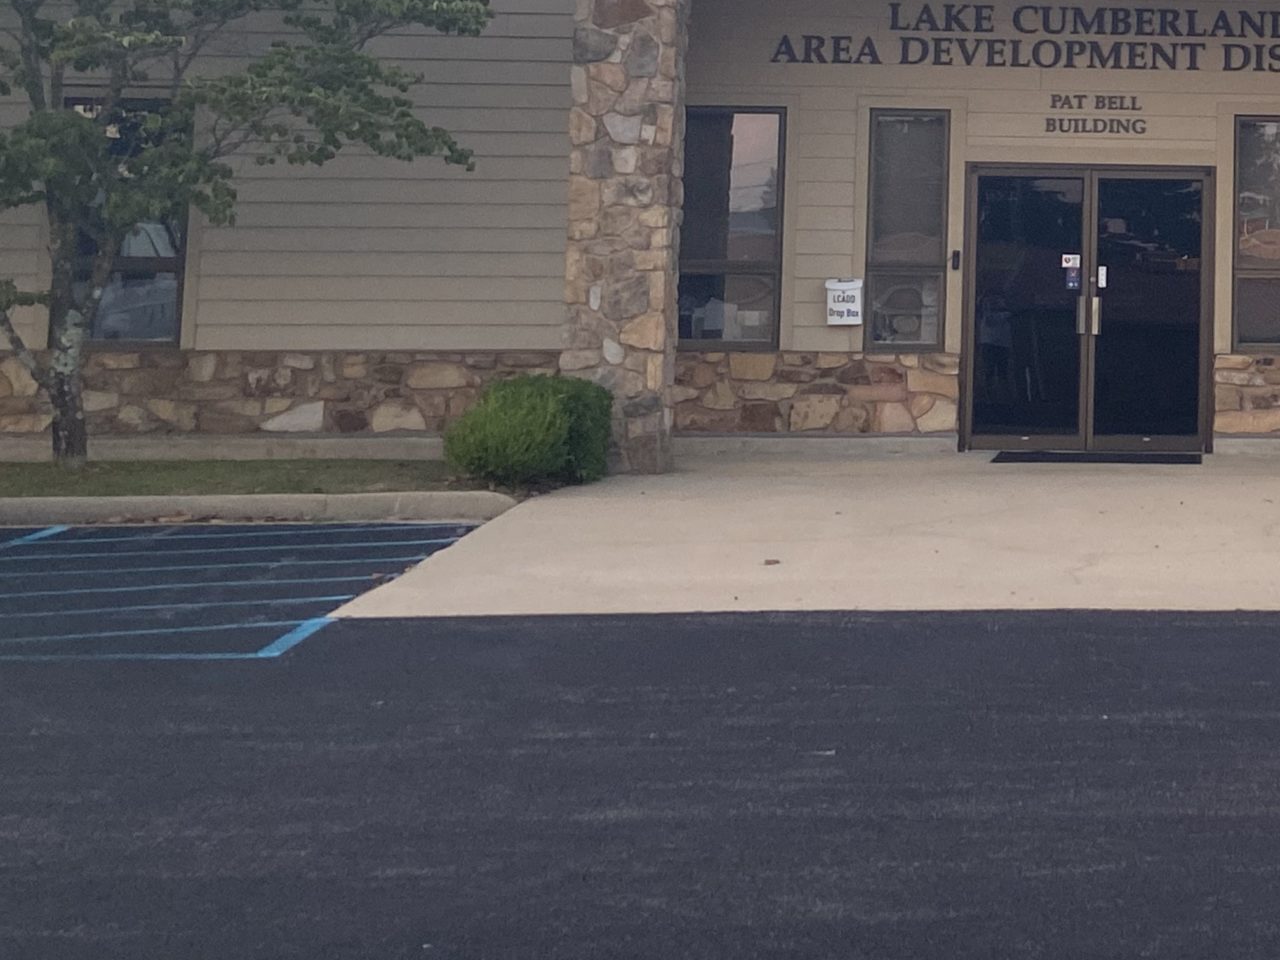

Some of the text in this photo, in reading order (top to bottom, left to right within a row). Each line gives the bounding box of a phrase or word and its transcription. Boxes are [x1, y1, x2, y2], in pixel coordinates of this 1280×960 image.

[888, 2, 995, 33] LAKE
[769, 34, 882, 65] AREA
[899, 36, 1206, 71] DEVELOPMENT
[1050, 94, 1143, 111] PAT BELL
[1045, 118, 1147, 135] BUILDING
[828, 307, 859, 319] Drop Box
